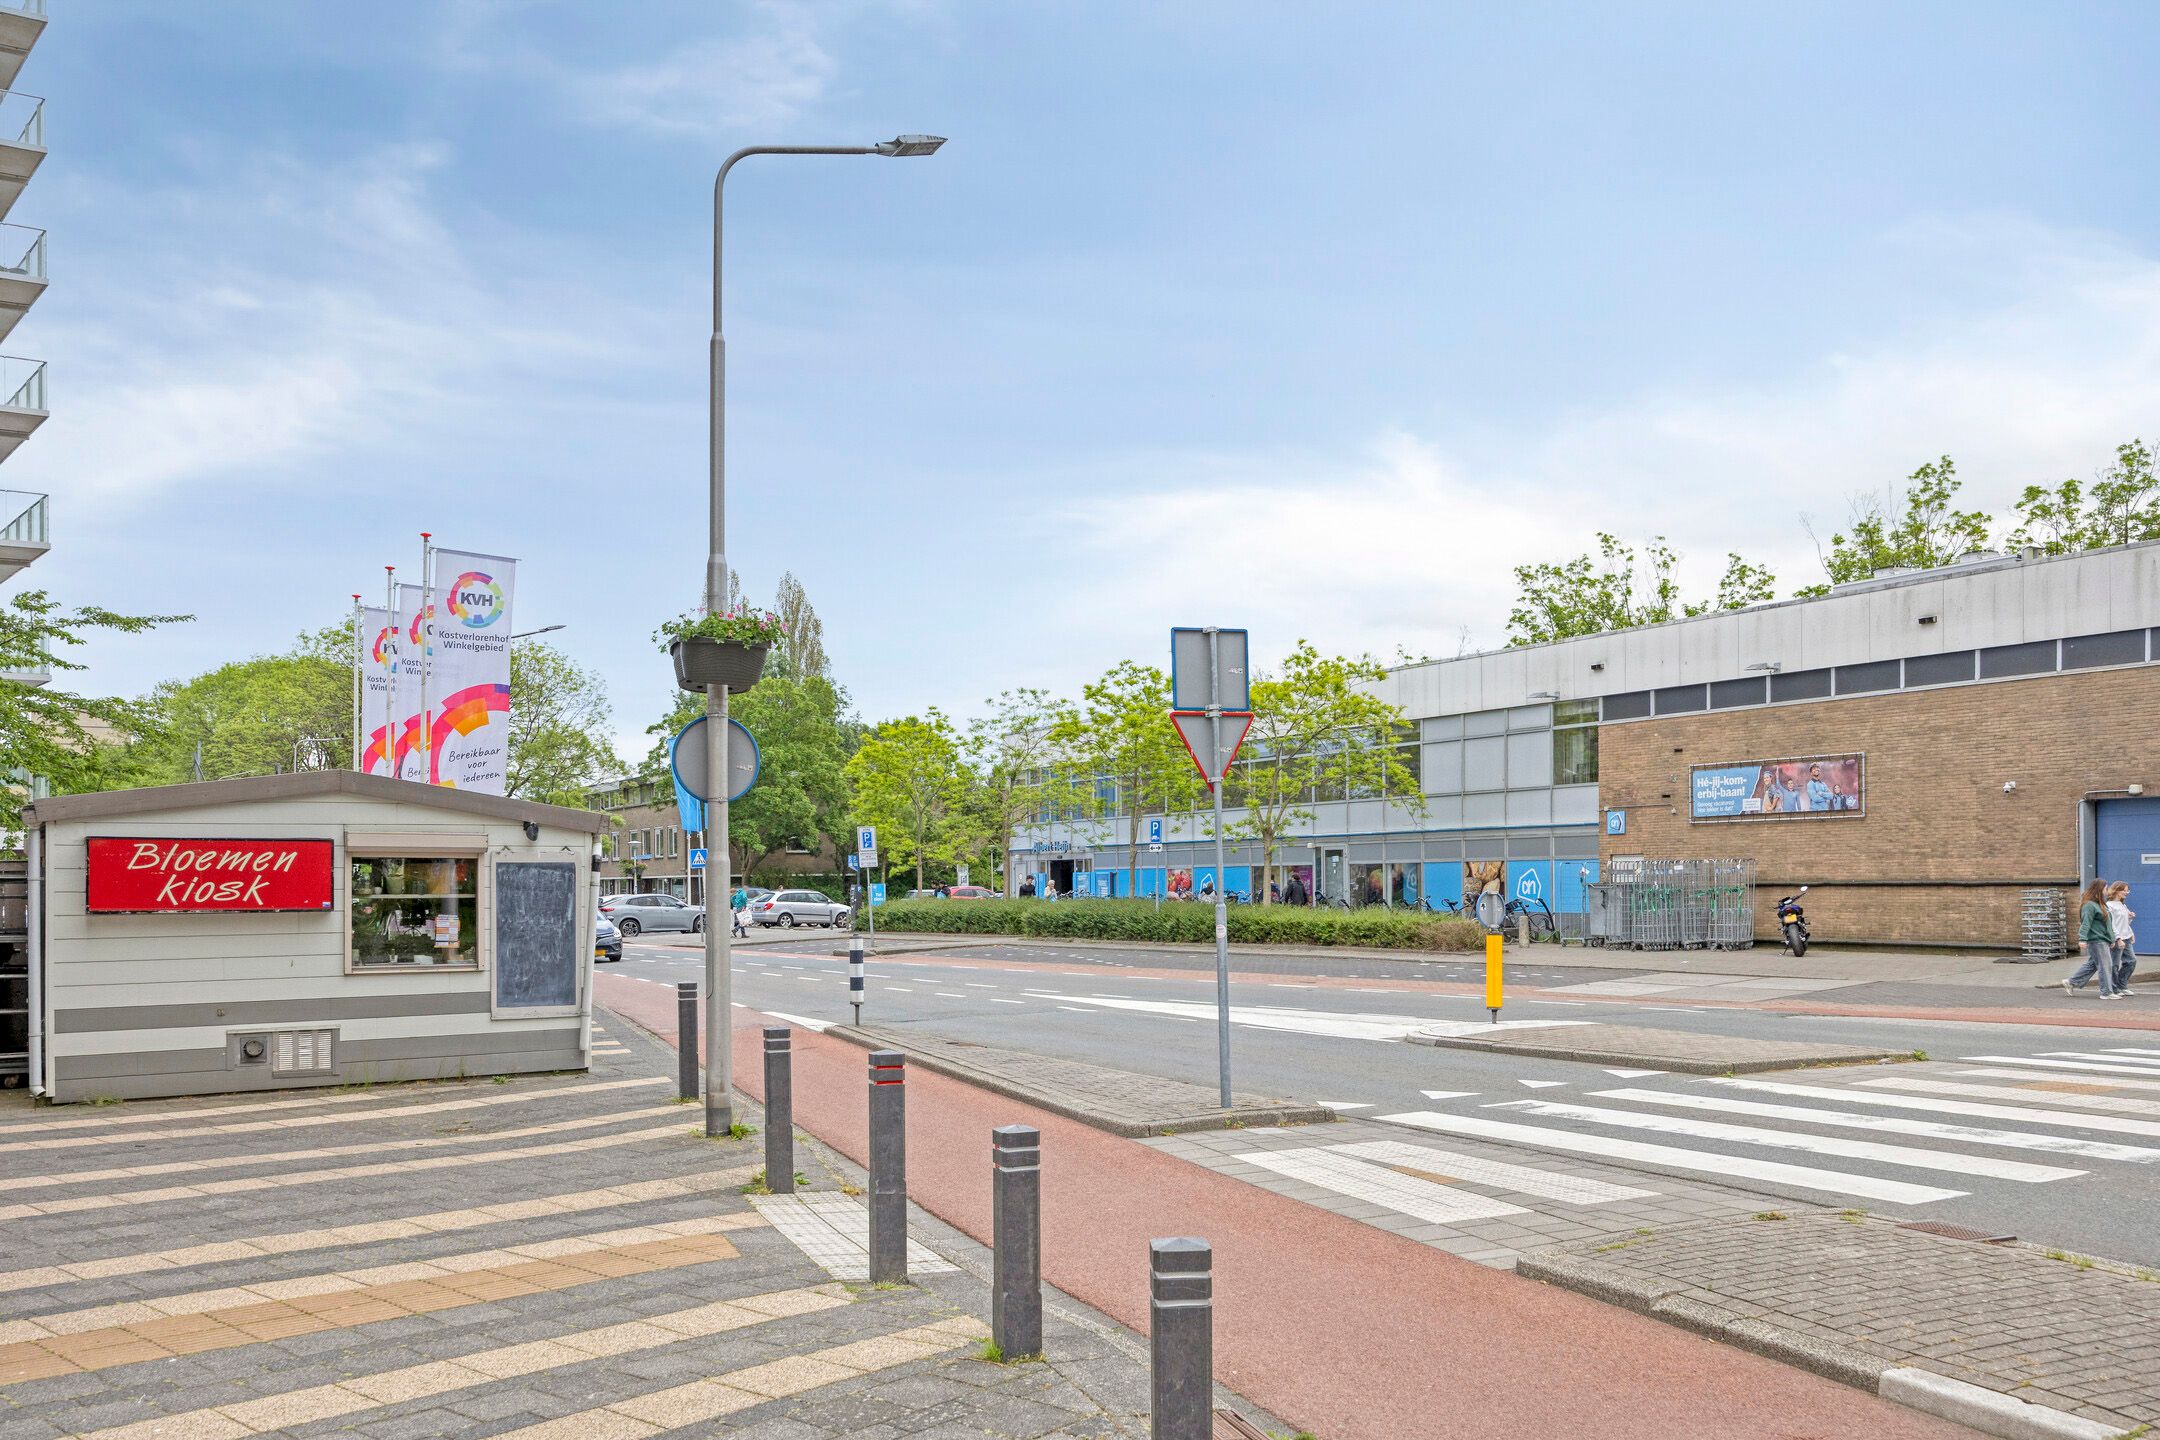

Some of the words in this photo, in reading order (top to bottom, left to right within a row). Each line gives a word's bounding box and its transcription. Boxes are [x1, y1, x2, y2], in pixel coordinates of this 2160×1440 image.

[460, 592, 493, 607] KVH
[438, 630, 509, 643] Kostverlorenhof
[443, 640, 504, 653] Winkelgebied
[448, 747, 501, 763] Bereikbaar
[467, 760, 487, 769] voor
[462, 771, 500, 783] iedereen
[1697, 775, 1747, 789] Hé-jij-kom-
[1697, 786, 1745, 800] erbij-baan!
[1152, 822, 1159, 834] P
[864, 833, 870, 842] P
[127, 843, 298, 872] Bloemen
